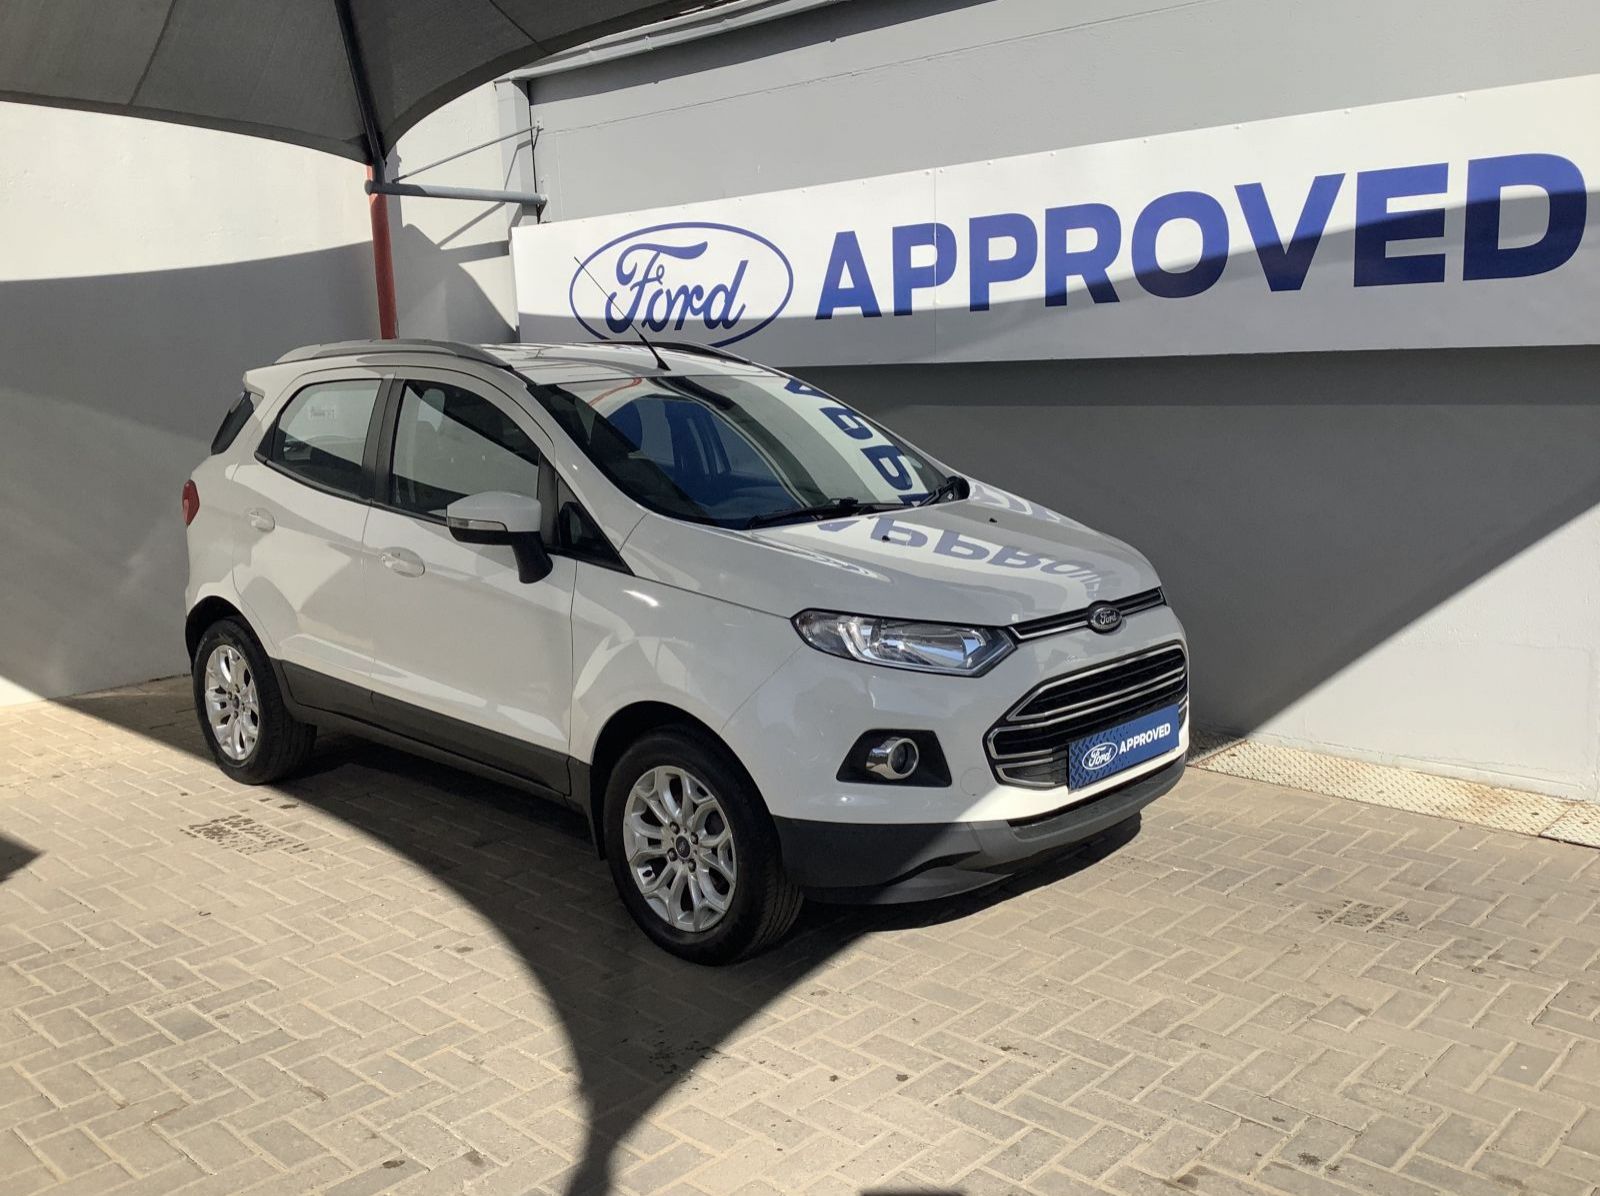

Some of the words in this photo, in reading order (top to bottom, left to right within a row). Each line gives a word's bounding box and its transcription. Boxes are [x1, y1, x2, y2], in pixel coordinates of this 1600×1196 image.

[605, 241, 749, 334] Ford
[815, 153, 1588, 319] APPROVED
[1088, 746, 1112, 768] Ford
[1119, 722, 1171, 755] APPROVED
